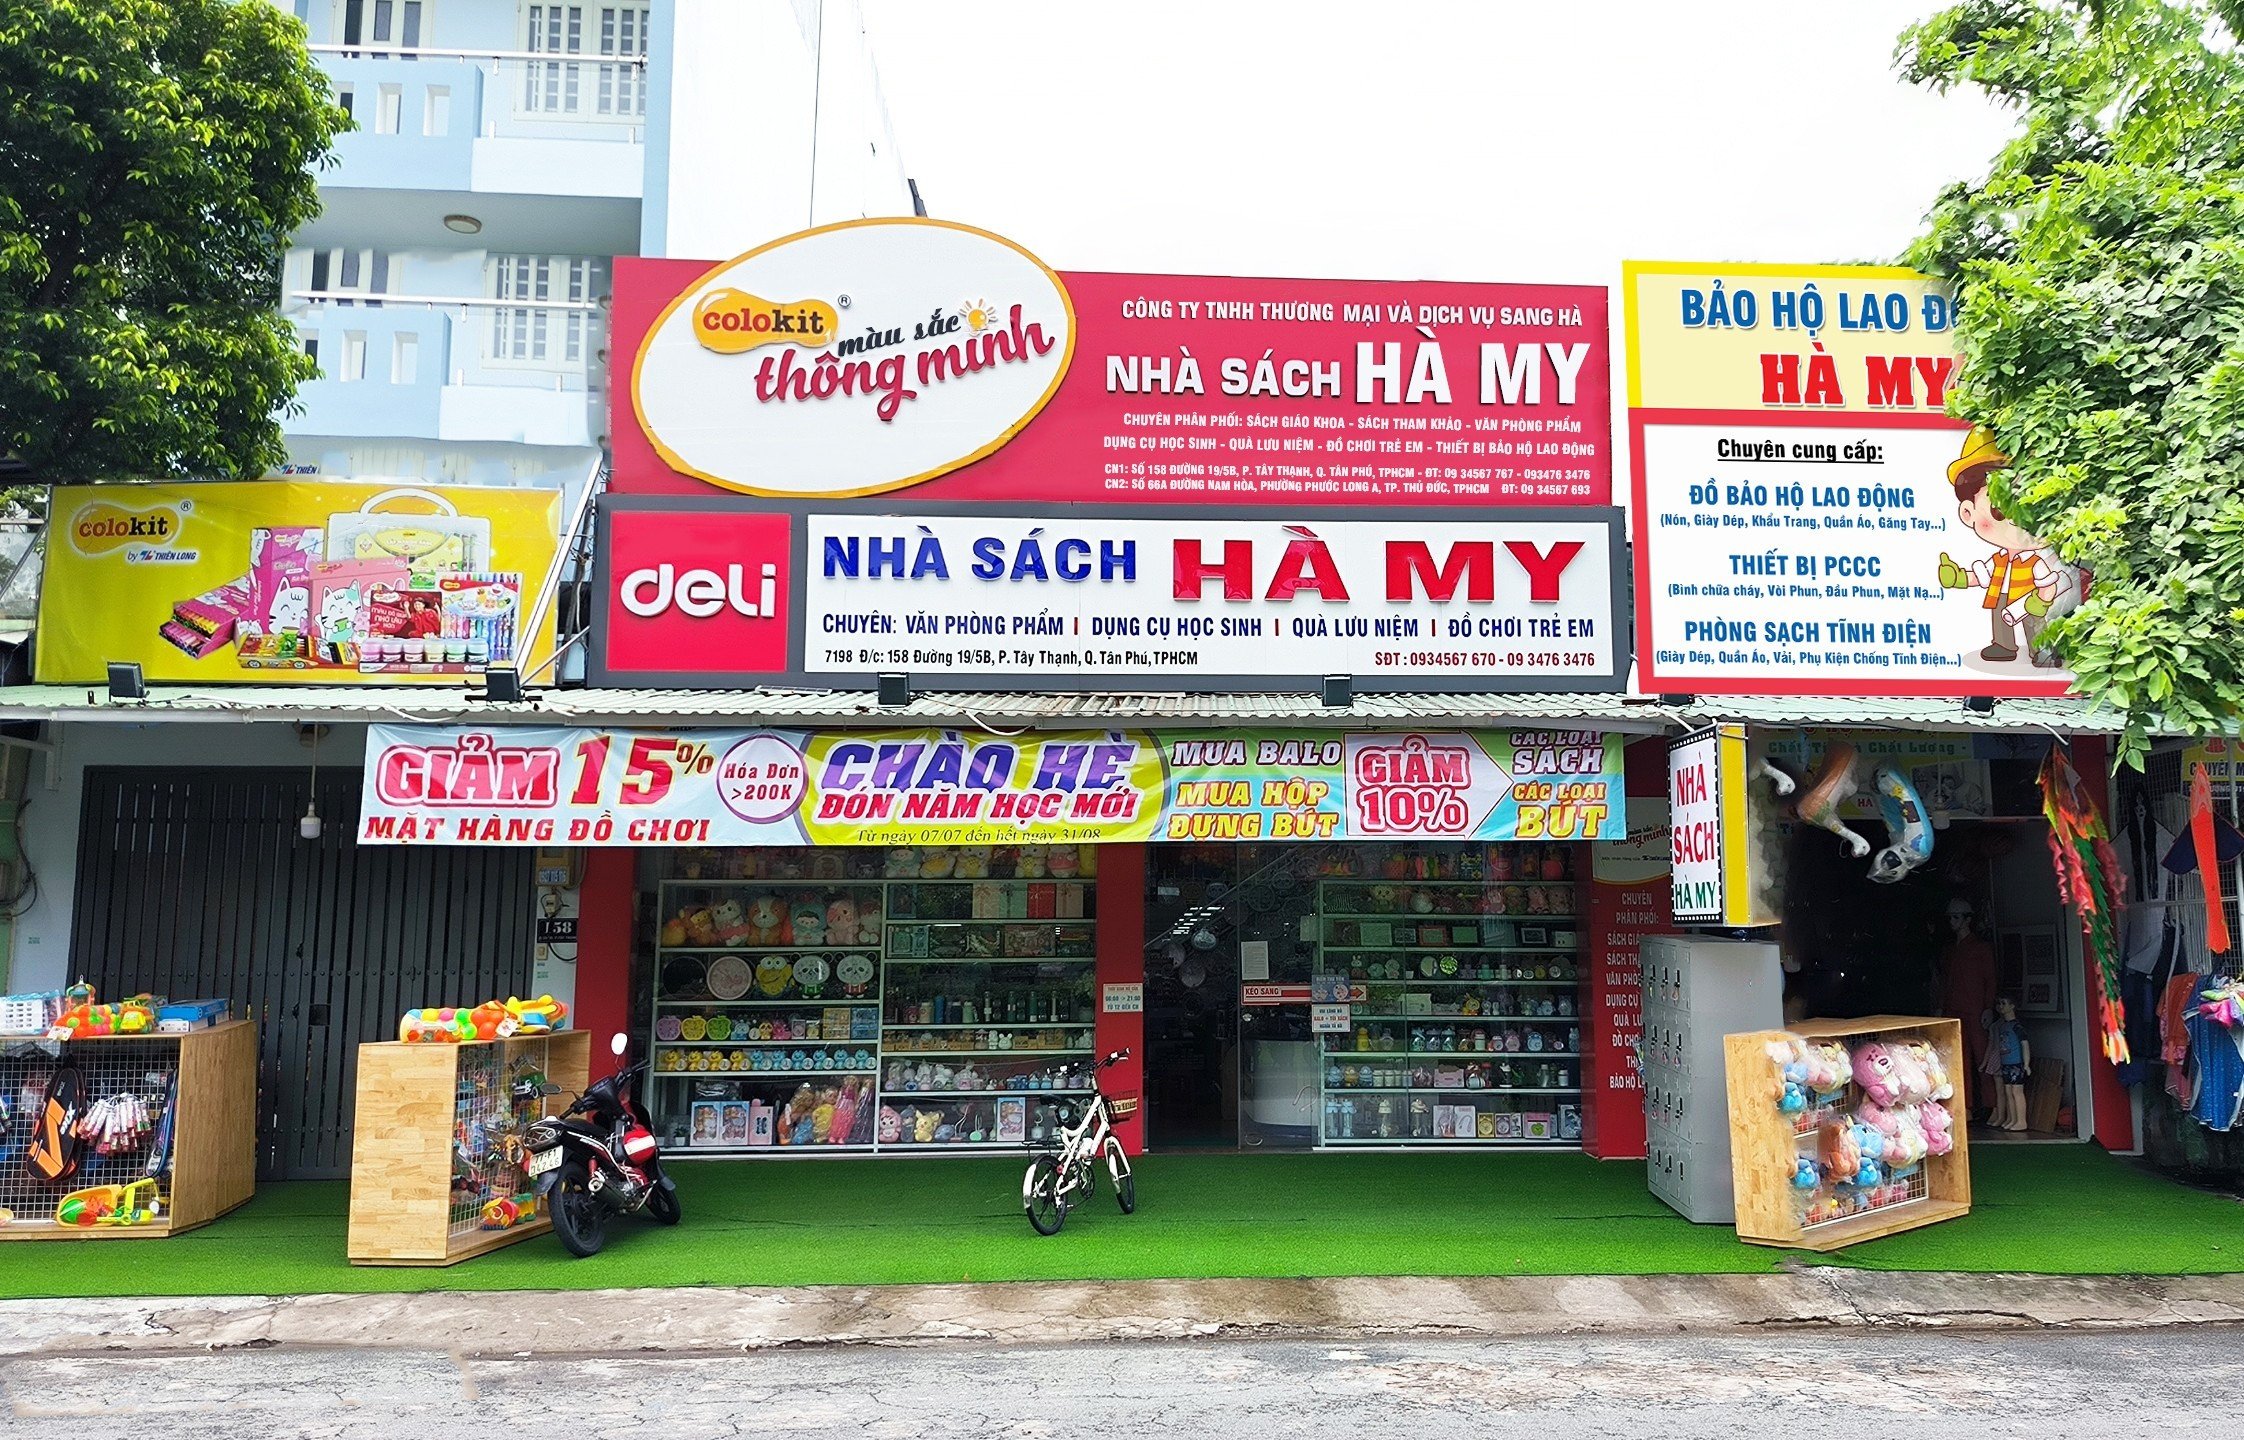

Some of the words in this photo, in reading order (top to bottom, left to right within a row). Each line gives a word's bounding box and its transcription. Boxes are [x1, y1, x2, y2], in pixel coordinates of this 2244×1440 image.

[703, 307, 823, 334] colokit
[1122, 296, 1172, 318] CÔNG
[1179, 302, 1200, 318] TY
[1206, 302, 1254, 320] TNHH
[1260, 301, 1334, 321] THƯƠNG
[1343, 304, 1380, 327] MẠI
[1387, 300, 1413, 323] VÀ
[1419, 305, 1463, 327] DỊCH
[1469, 306, 1494, 329] VỤ
[1501, 307, 1553, 325] SANG
[1558, 304, 1582, 326] HÀ
[1681, 279, 1757, 327] BẢO
[1772, 282, 1824, 337] HỘ
[1839, 293, 1908, 331] LAO
[838, 326, 905, 357] màu
[913, 308, 961, 342] sắc
[754, 348, 917, 423] thông
[917, 303, 1055, 385] minh
[1106, 346, 1204, 394] NHÀ
[1221, 349, 1340, 396] SÁCH
[1356, 326, 1452, 403] HÀ
[1481, 343, 1591, 404] MY
[1761, 341, 1844, 405] HÀ
[1866, 356, 1958, 406] MY
[1124, 413, 1170, 426] CHUYÊN
[1175, 413, 1207, 426] PHÂN
[1210, 411, 1242, 427] PHỐI:
[1246, 413, 1277, 427] SÁCH
[1282, 414, 1309, 428] GIÁO
[1314, 416, 1345, 428] KHOA
[1357, 415, 1389, 429] SÁCH
[1393, 418, 1426, 430] THAM
[1431, 416, 1462, 430] KHẢO
[1475, 417, 1498, 430] VĂN
[1502, 417, 1542, 432] PHÒNG
[1546, 415, 1581, 433] PHẨM
[1718, 438, 1785, 461] Chuyên
[1792, 444, 1836, 462] cung
[1843, 438, 1883, 461] cấp:
[1689, 478, 1718, 505] ĐỒ
[1727, 481, 1768, 507] BẢO
[1776, 481, 1804, 511] HỘ
[1812, 487, 1850, 508] LAO
[1858, 483, 1914, 512] ĐỘNG
[79, 517, 168, 537] colokit
[1660, 512, 1690, 528] (Nón,
[1694, 513, 1719, 528] Giày
[1723, 513, 1749, 529] Dép,
[1752, 512, 1781, 528] Khẩu
[1784, 516, 1820, 529] Trang,
[1824, 513, 1854, 529] Quần
[1857, 513, 1874, 530] Áo,
[1879, 514, 1907, 531] Găng
[1912, 516, 1946, 531] Tay...)
[127, 552, 137, 562] by
[155, 550, 175, 560] THIÊN
[177, 552, 196, 560] LONG
[824, 526, 949, 580] NHÀ
[971, 528, 1136, 582] SÁCH
[1173, 524, 1350, 602] HÀ
[1386, 540, 1586, 604] MY
[1729, 549, 1788, 576] THIẾT
[1796, 556, 1817, 580] BỊ
[1825, 556, 1881, 577] PCCC
[620, 563, 776, 618] deli
[823, 610, 897, 634] CHUYÊN:
[906, 611, 938, 635] VĂN
[947, 610, 1005, 634] PHÒNG
[1013, 607, 1063, 635] PHẨM
[1093, 617, 1139, 640] DỤNG
[1147, 618, 1169, 640] CỤ
[1178, 618, 1213, 640] HỌC
[1221, 618, 1262, 636] SINH
[1293, 614, 1327, 638] QUÀ
[1335, 615, 1368, 637] LƯU
[1375, 615, 1418, 641] NIỆM
[1448, 611, 1472, 637] ĐỒ
[1479, 616, 1521, 638] CHƠI
[1528, 613, 1562, 638] TRẺ
[1568, 619, 1594, 638] EM
[1685, 616, 1756, 642] PHÒNG
[1764, 622, 1819, 646] SẠCH
[1827, 618, 1874, 642] TĨNH
[1882, 619, 1931, 648] ĐIỆN
[825, 650, 853, 663] 7198
[860, 649, 883, 663] Đ/c:
[887, 651, 908, 663] 158
[914, 650, 953, 666] Đường
[958, 650, 995, 665] 19/5B,
[999, 651, 1010, 663] P.
[1013, 649, 1035, 665] Tây
[1039, 651, 1081, 667] Thạnh,
[1085, 651, 1096, 665] Q.
[1100, 650, 1121, 664] Tân
[1126, 651, 1152, 667] Phú,
[1154, 651, 1198, 665] TPHCM
[1375, 652, 1400, 666] SĐT
[1410, 653, 1468, 666] 0934567
[1471, 653, 1496, 666] 670
[1508, 653, 1522, 666] 09
[1528, 653, 1559, 666] 3476
[1563, 653, 1594, 666] 3476
[1171, 741, 1246, 765] MUA
[1256, 741, 1342, 765] BALO
[1554, 731, 1603, 748] LOẠI
[376, 733, 562, 808] GIẢM
[570, 735, 716, 807] 15%
[724, 763, 757, 779] Hóa
[766, 763, 799, 779] Đơn
[819, 730, 1016, 791] CHÀO
[1031, 729, 1141, 792] HÈ
[1357, 734, 1469, 789] GIẢM
[1511, 745, 1605, 774] SÁCH
[731, 784, 792, 801] >200K
[1176, 781, 1252, 806] MUA
[1261, 776, 1329, 810] HỘP
[1512, 781, 1551, 800] CÁC
[1557, 782, 1606, 803] LOẠI
[1676, 753, 1707, 807] NHÀ
[817, 787, 894, 819] ĐÓN
[901, 788, 979, 819] NĂM
[989, 792, 1062, 824] HỌC
[1069, 787, 1139, 818] MỚI
[1358, 787, 1469, 832] 10%
[1515, 800, 1608, 838] BÚT
[364, 812, 445, 843] MẶT
[457, 813, 553, 841] HÀNG
[568, 810, 620, 841] ĐỒ
[628, 818, 711, 841] CHƠI
[858, 829, 875, 841] Từ
[880, 830, 916, 844] ngày
[920, 830, 961, 841] 07/07
[965, 828, 990, 841] đến
[996, 826, 1018, 840] hết
[1021, 831, 1056, 844] ngày
[1059, 829, 1101, 840] 31/08
[1167, 811, 1262, 841] ĐỰNG
[1272, 813, 1339, 838] BÚT
[1674, 813, 1715, 865] SÁCH
[1622, 890, 1652, 905] CHUYÊN
[1674, 874, 1693, 909] HÀ
[1696, 882, 1716, 909] MY
[545, 922, 572, 933] 158
[1262, 987, 1279, 996] SANG
[1610, 1075, 1624, 1088] BẢO
[1626, 1076, 1635, 1090] HỘ
